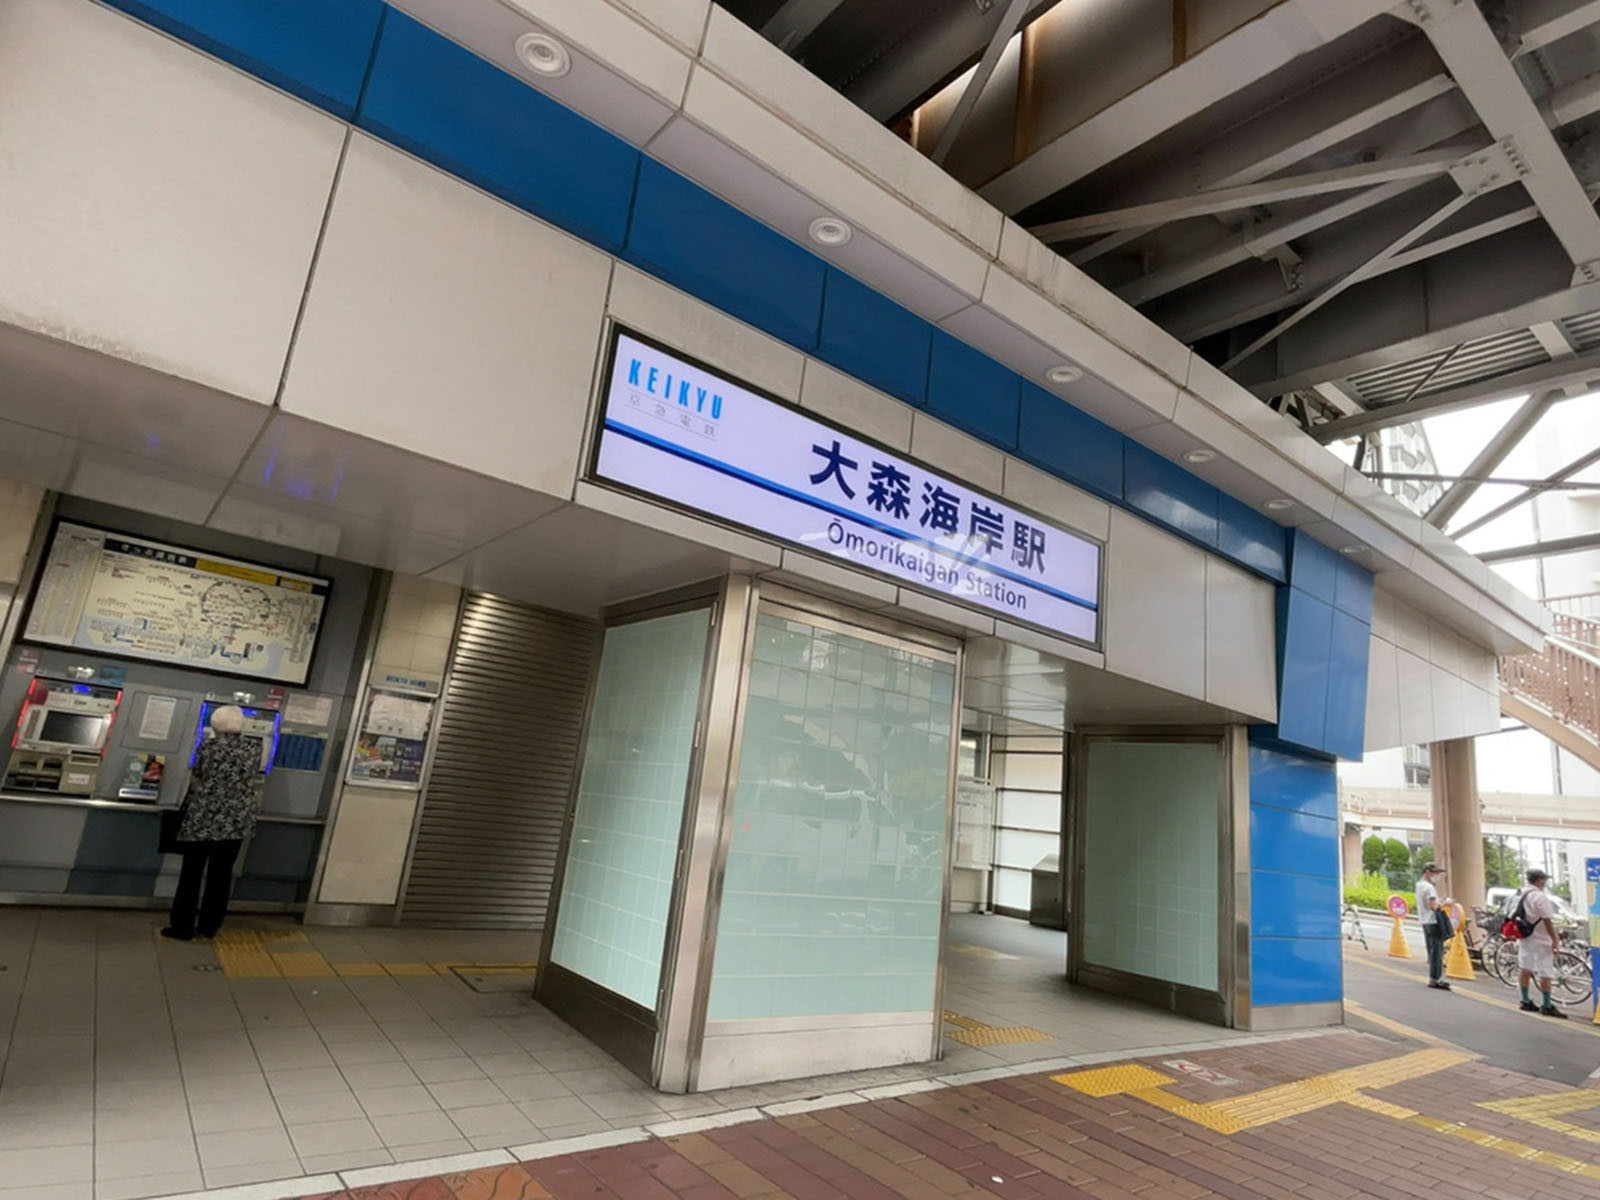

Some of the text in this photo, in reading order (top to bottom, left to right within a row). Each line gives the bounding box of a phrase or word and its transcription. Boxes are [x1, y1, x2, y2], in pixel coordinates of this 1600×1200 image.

[628, 358, 723, 420] KEIKYU
[809, 440, 1046, 574] 大森海岸駅
[827, 518, 1027, 610] Ōmorikaigan Station
